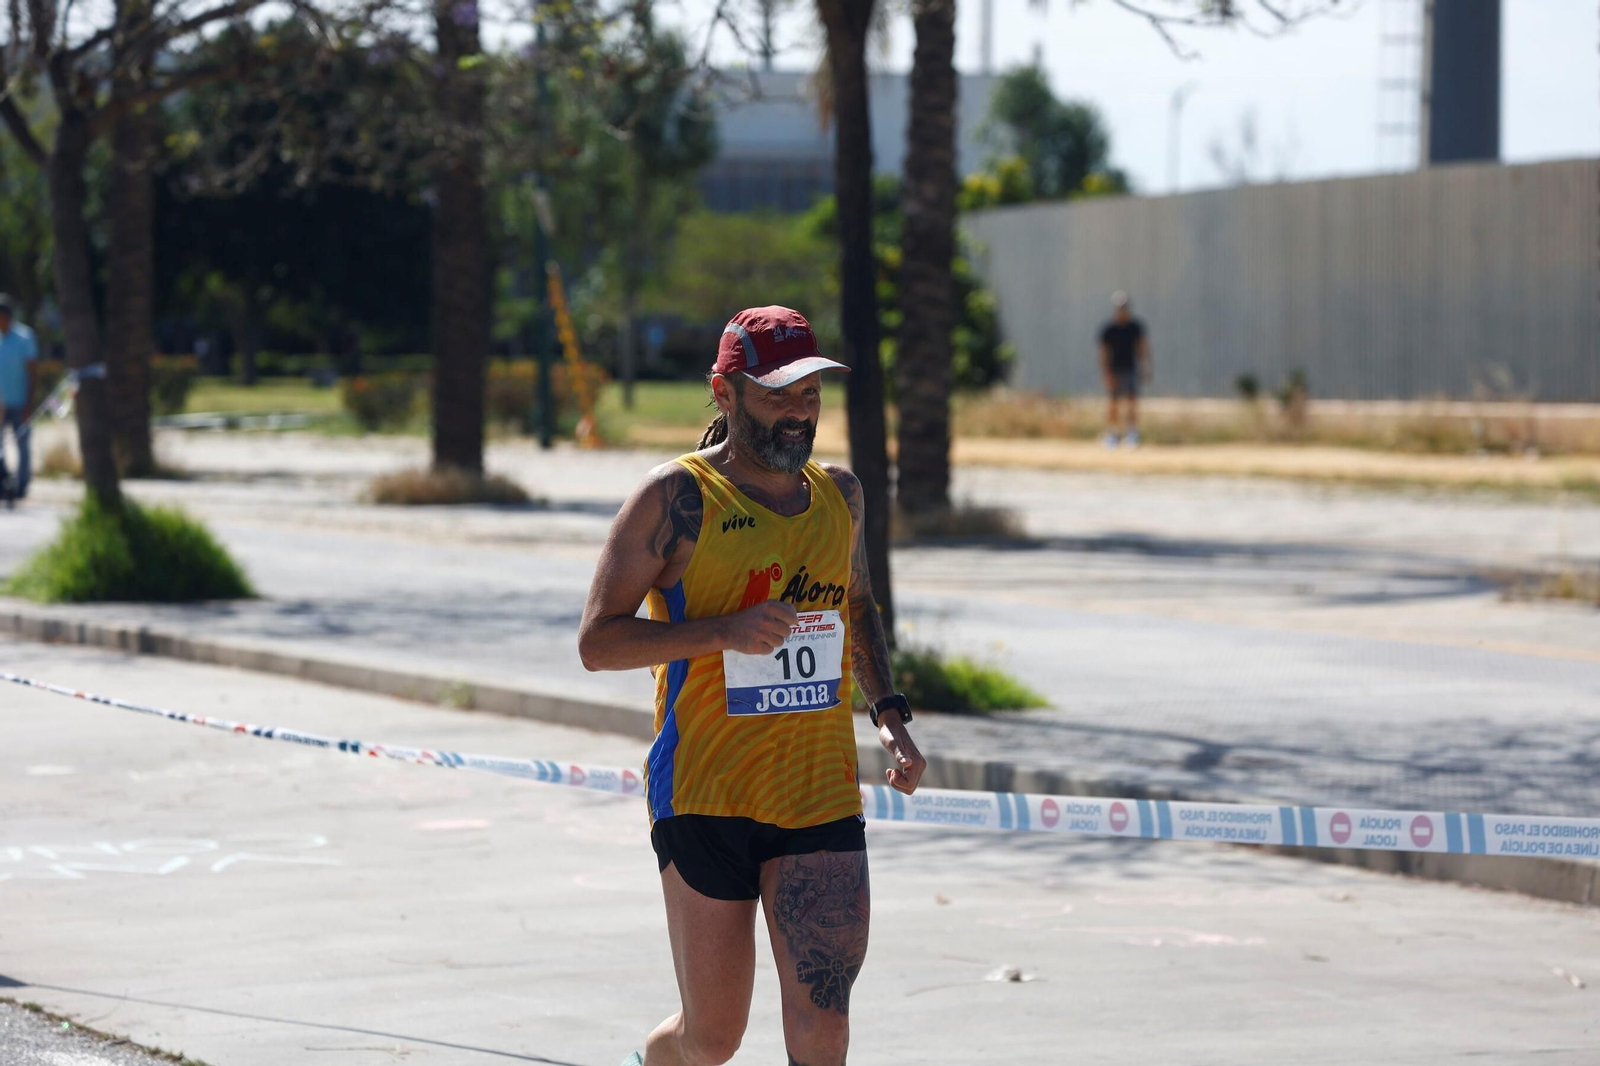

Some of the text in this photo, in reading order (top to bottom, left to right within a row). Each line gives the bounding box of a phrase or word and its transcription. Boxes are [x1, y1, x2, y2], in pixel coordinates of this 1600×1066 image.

[780, 565, 846, 606] Álora
[791, 623, 835, 634] TLETISMO
[797, 613, 823, 624] FEA
[774, 645, 816, 680] 10
